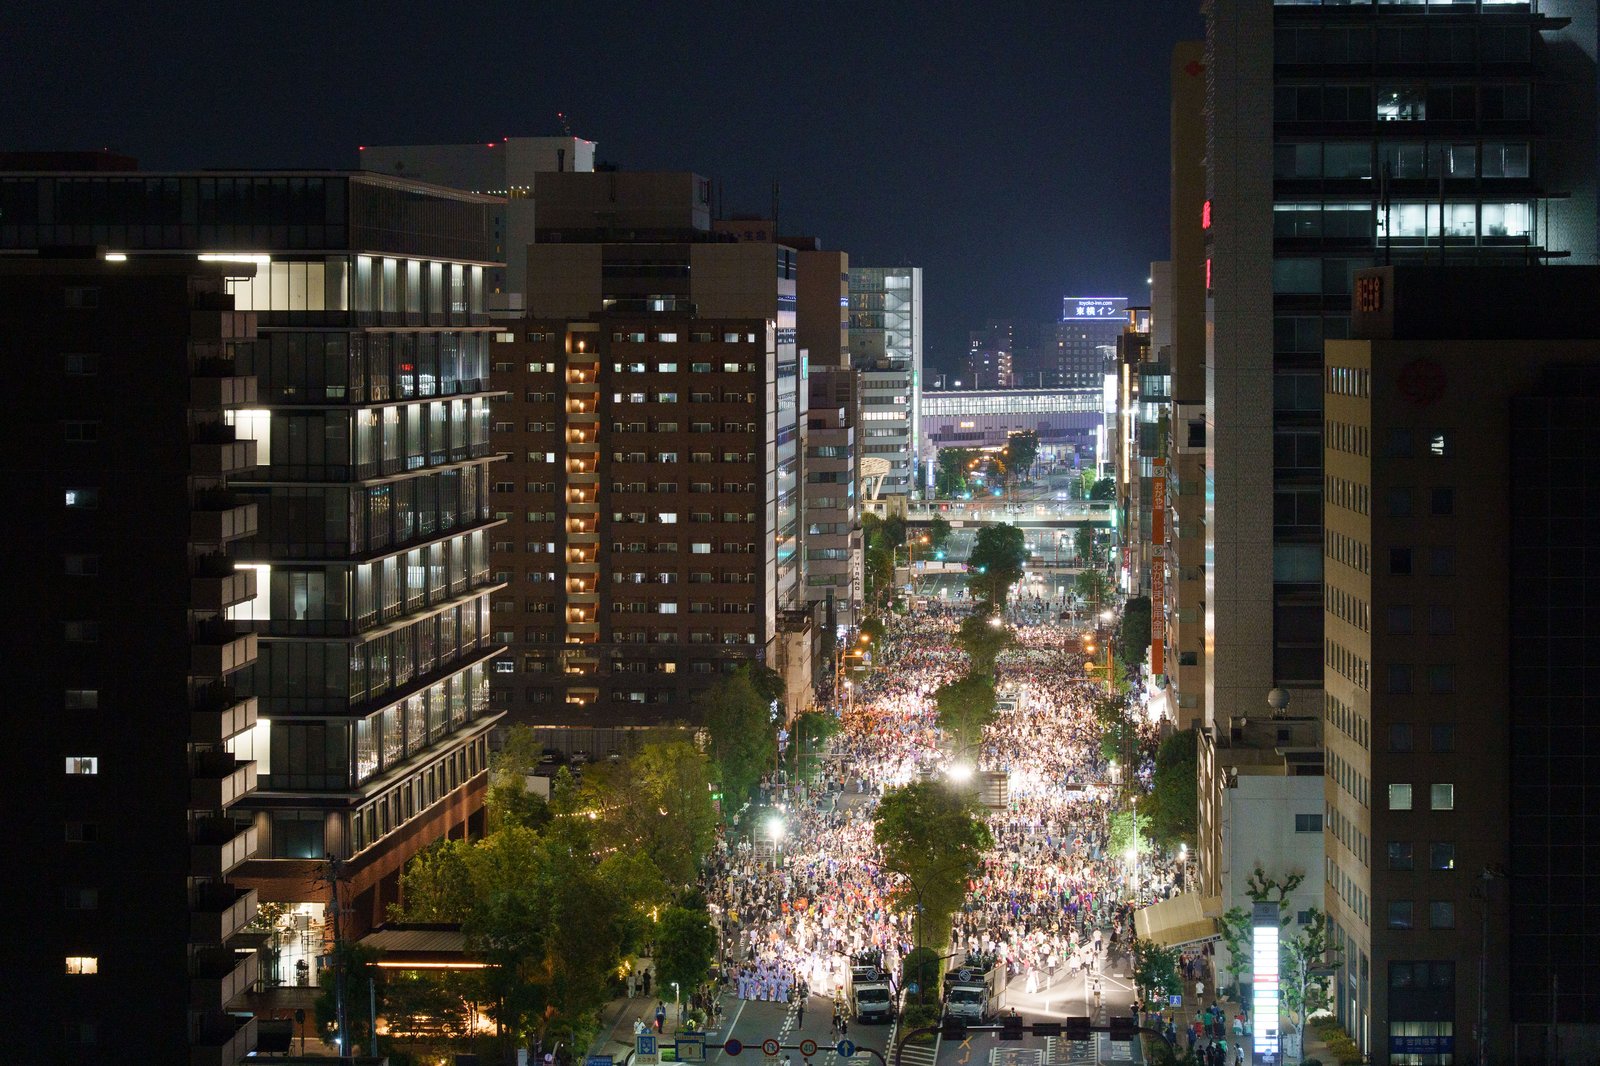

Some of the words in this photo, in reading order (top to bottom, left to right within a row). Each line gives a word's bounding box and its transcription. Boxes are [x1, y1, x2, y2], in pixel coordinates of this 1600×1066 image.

[1076, 306, 1116, 316] 東横イン
[803, 1044, 814, 1053] 40
